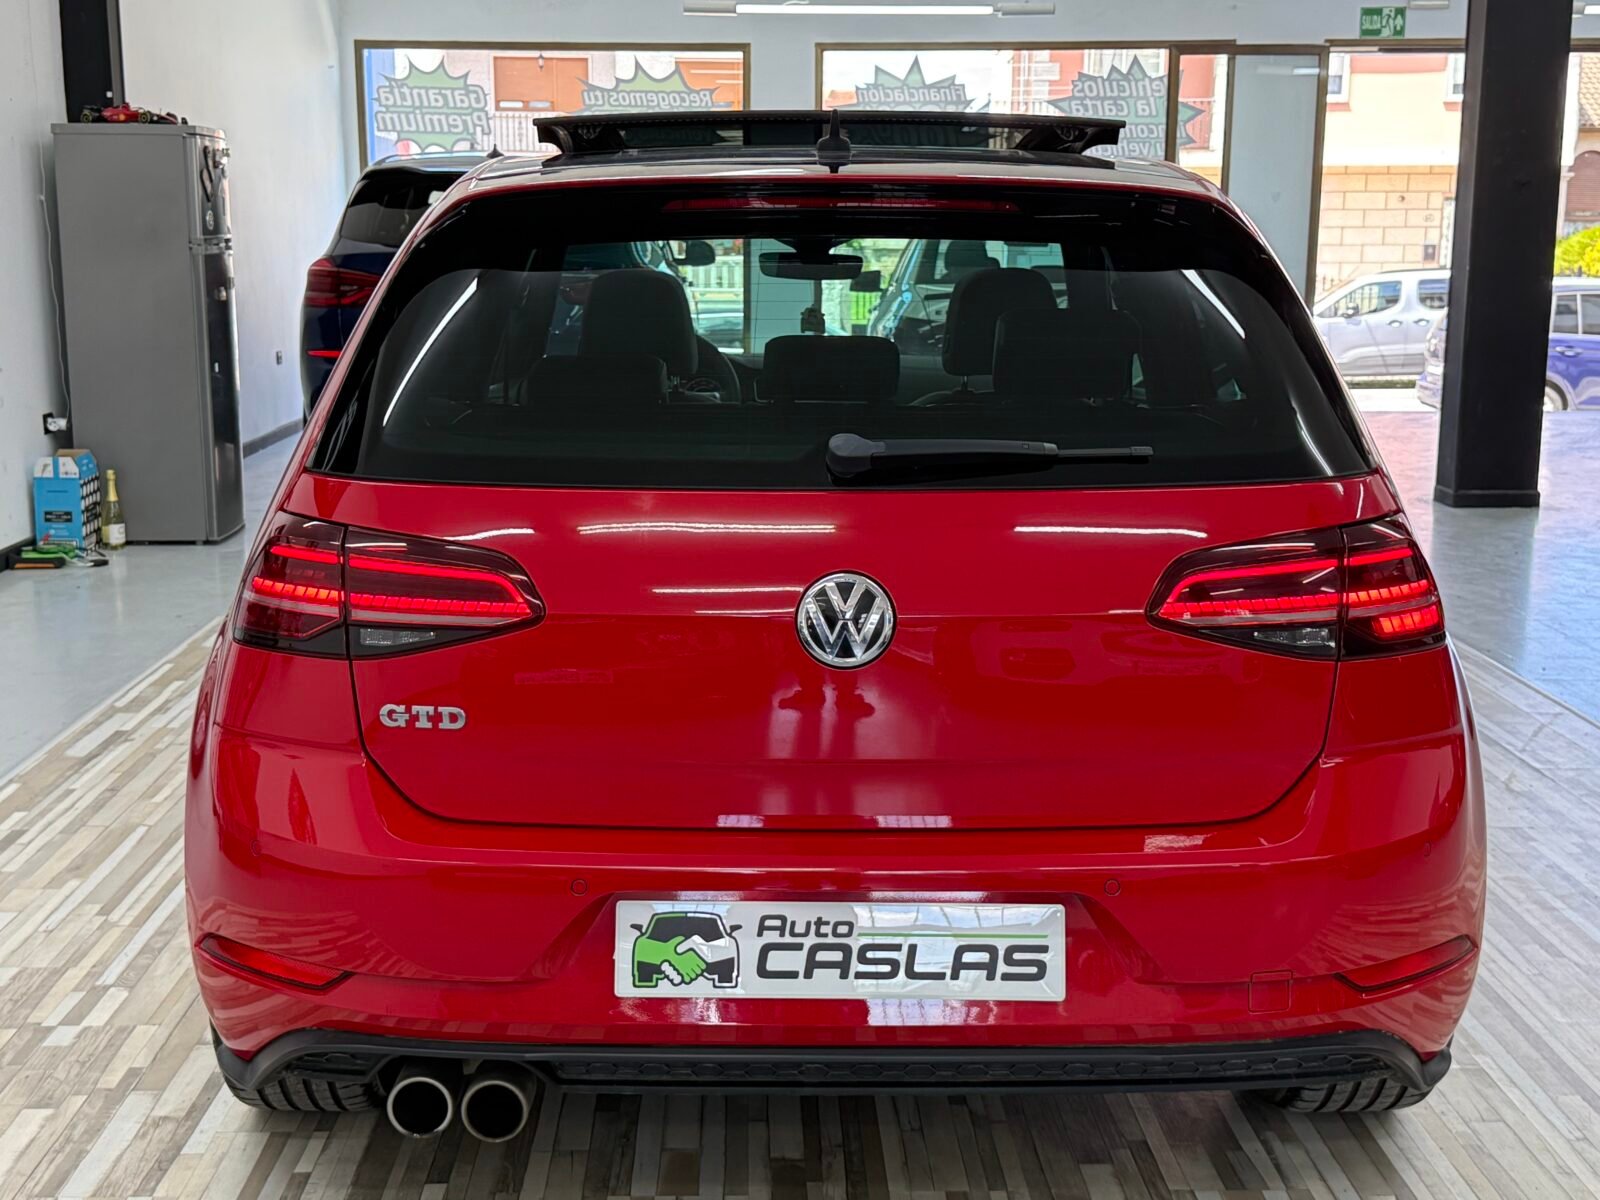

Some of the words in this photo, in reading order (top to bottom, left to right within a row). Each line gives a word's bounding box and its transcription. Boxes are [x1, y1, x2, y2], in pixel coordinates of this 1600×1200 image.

[1362, 15, 1381, 30] SALIDA
[379, 704, 467, 730] GTD
[757, 914, 854, 939] Auto
[756, 942, 1050, 982] CASLAS
